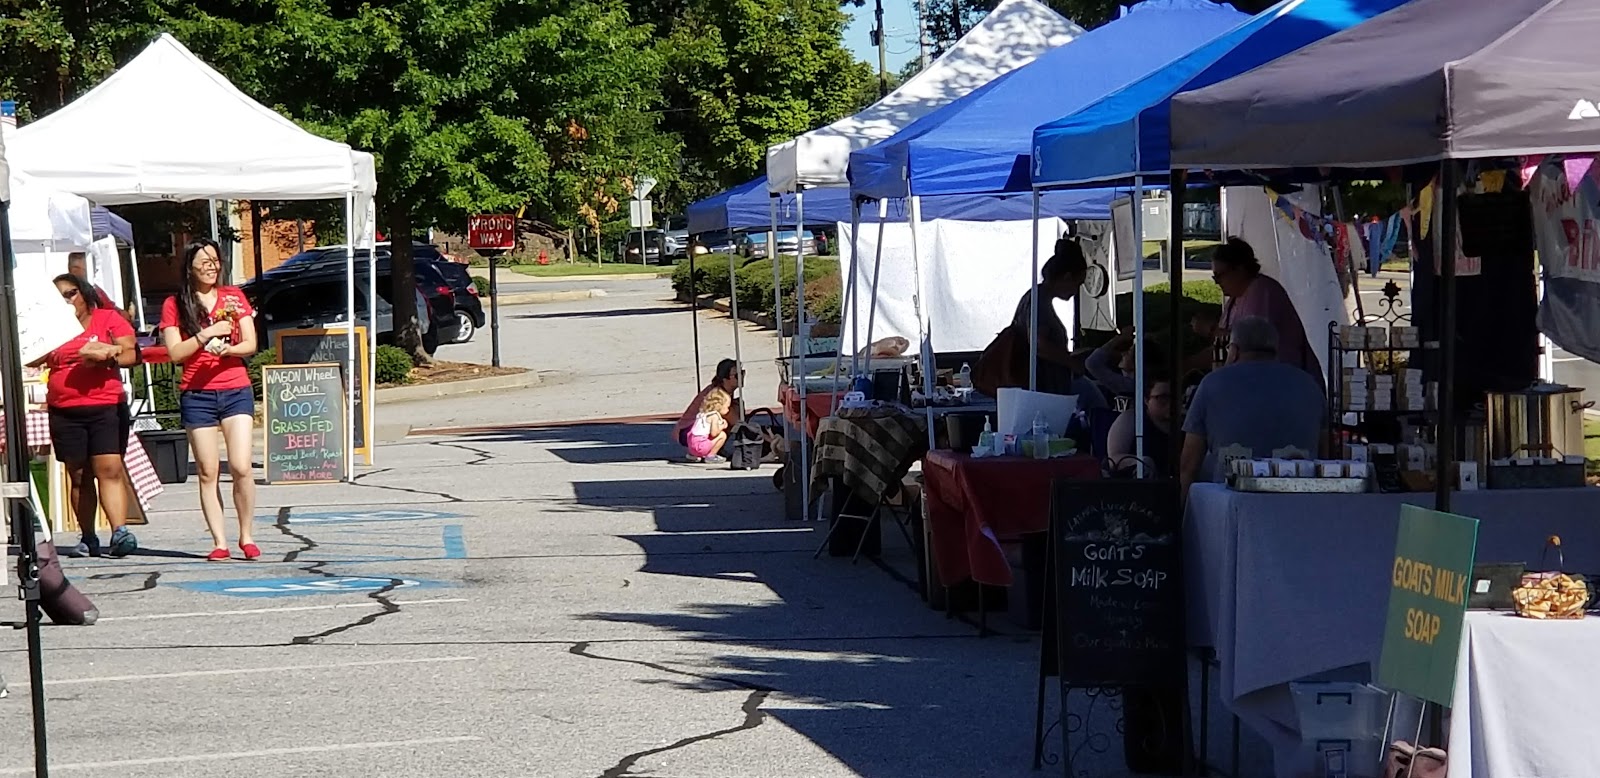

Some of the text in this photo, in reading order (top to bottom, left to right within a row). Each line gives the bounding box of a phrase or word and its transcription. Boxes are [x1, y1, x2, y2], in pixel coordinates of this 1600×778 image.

[471, 218, 512, 230] WRONG
[480, 232, 502, 245] WAY
[321, 336, 348, 350] Whee
[267, 369, 301, 384] WAGON
[271, 415, 333, 434] GRASS FED
[284, 432, 325, 449] BEEF!
[269, 452, 298, 462] Ground
[322, 460, 338, 469] And
[1071, 565, 1167, 589] Milk SOAP
[1393, 556, 1467, 605] GOATS MILK
[1405, 608, 1441, 645] SOAP
